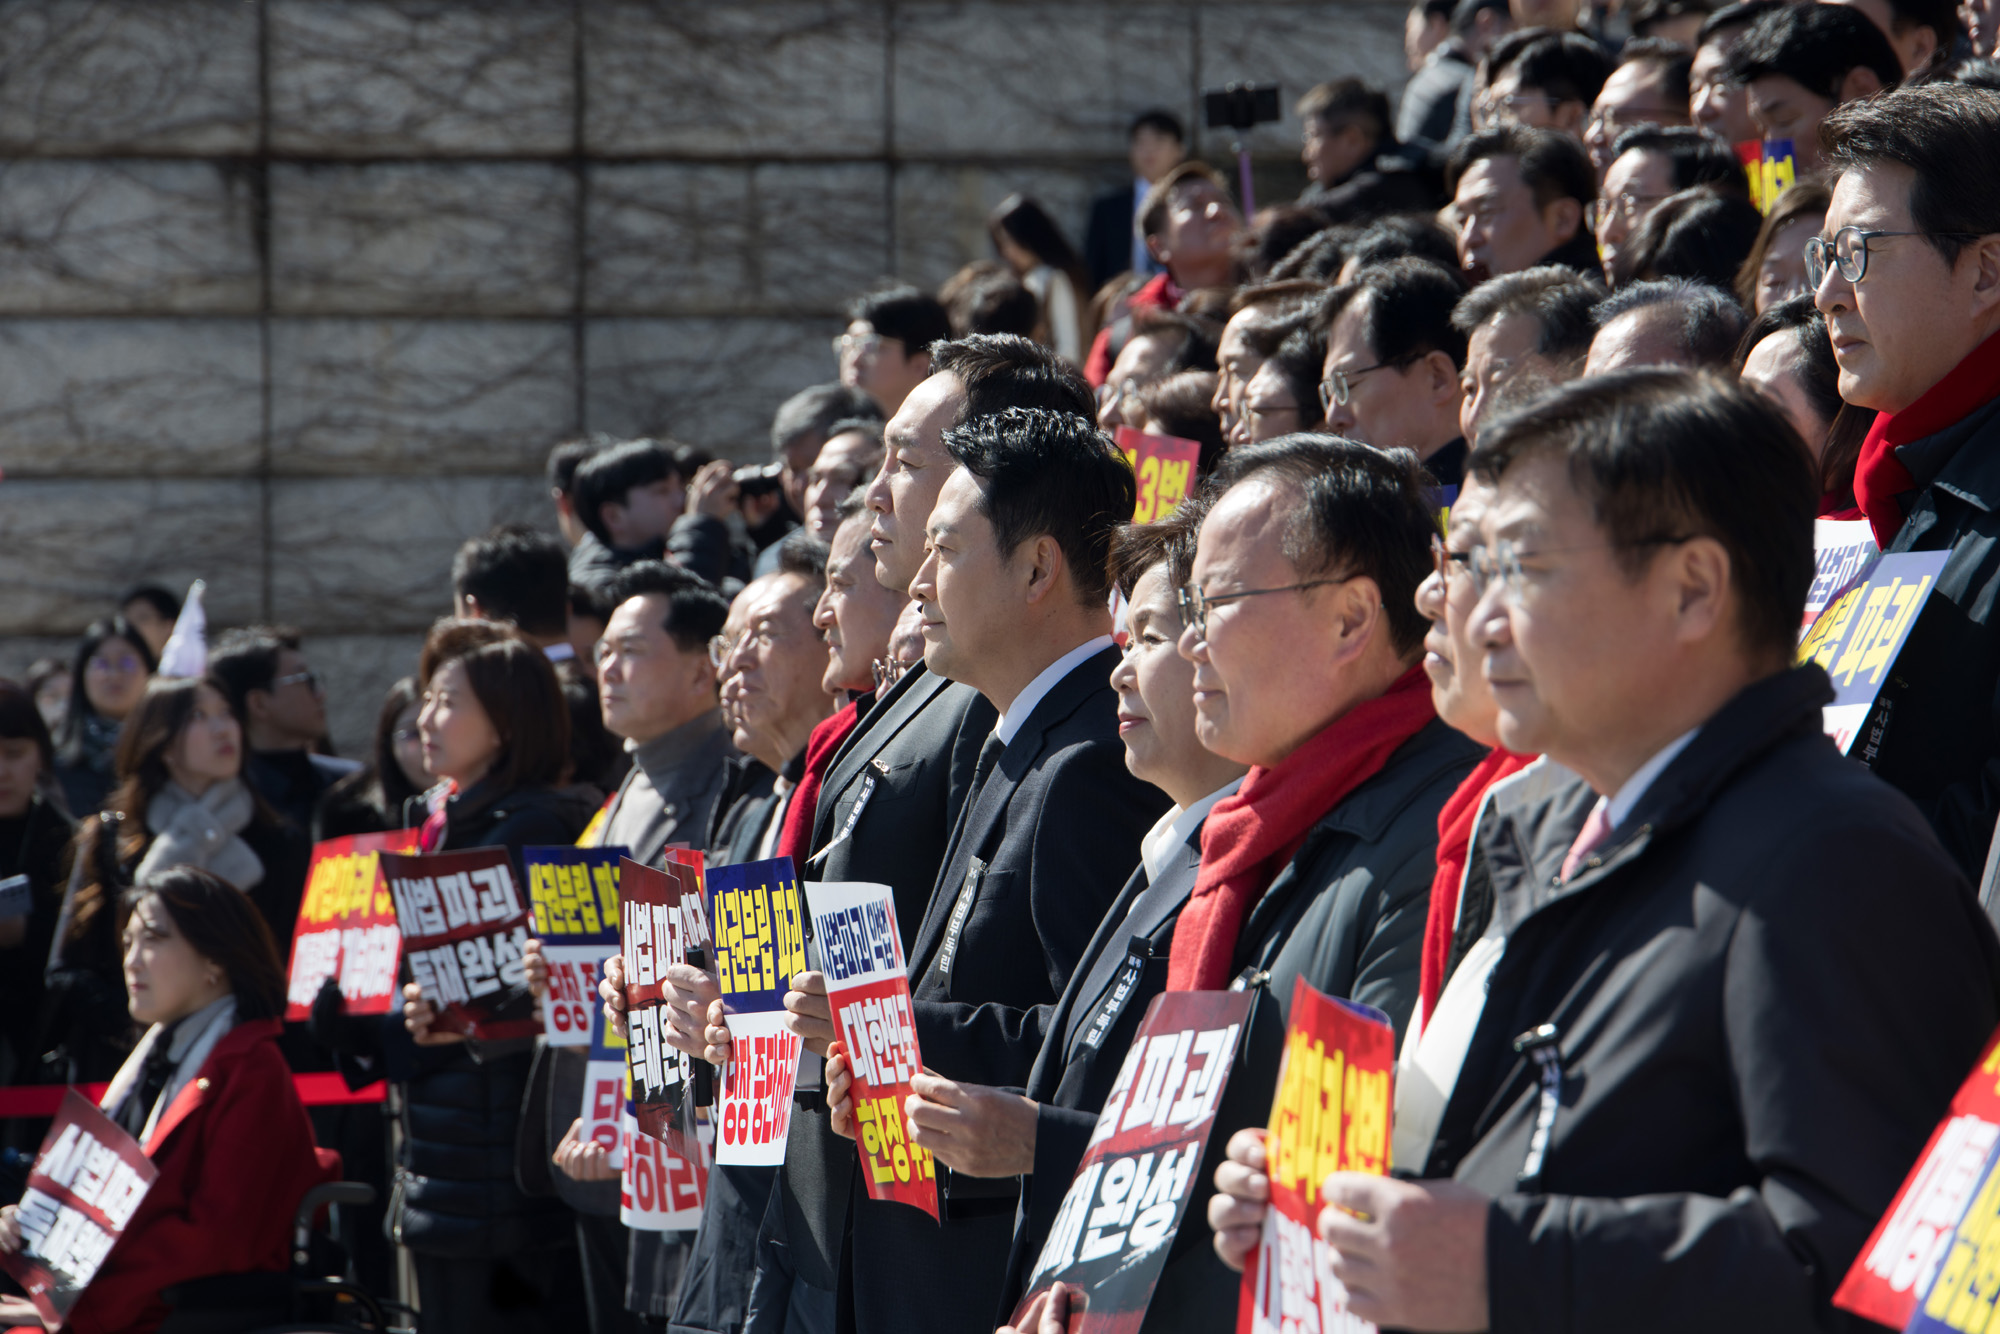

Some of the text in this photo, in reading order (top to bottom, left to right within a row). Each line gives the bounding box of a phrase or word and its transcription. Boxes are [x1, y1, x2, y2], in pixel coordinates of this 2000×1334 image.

[1832, 575, 1932, 687] 파괴
[530, 862, 601, 934] 삼권분립
[714, 880, 807, 994] 삼권분립 파괴
[816, 904, 875, 980] 사법파괴
[839, 994, 917, 1086] 대한민국
[1086, 969, 1138, 1046] 사법부독립
[724, 1035, 751, 1145] 당장
